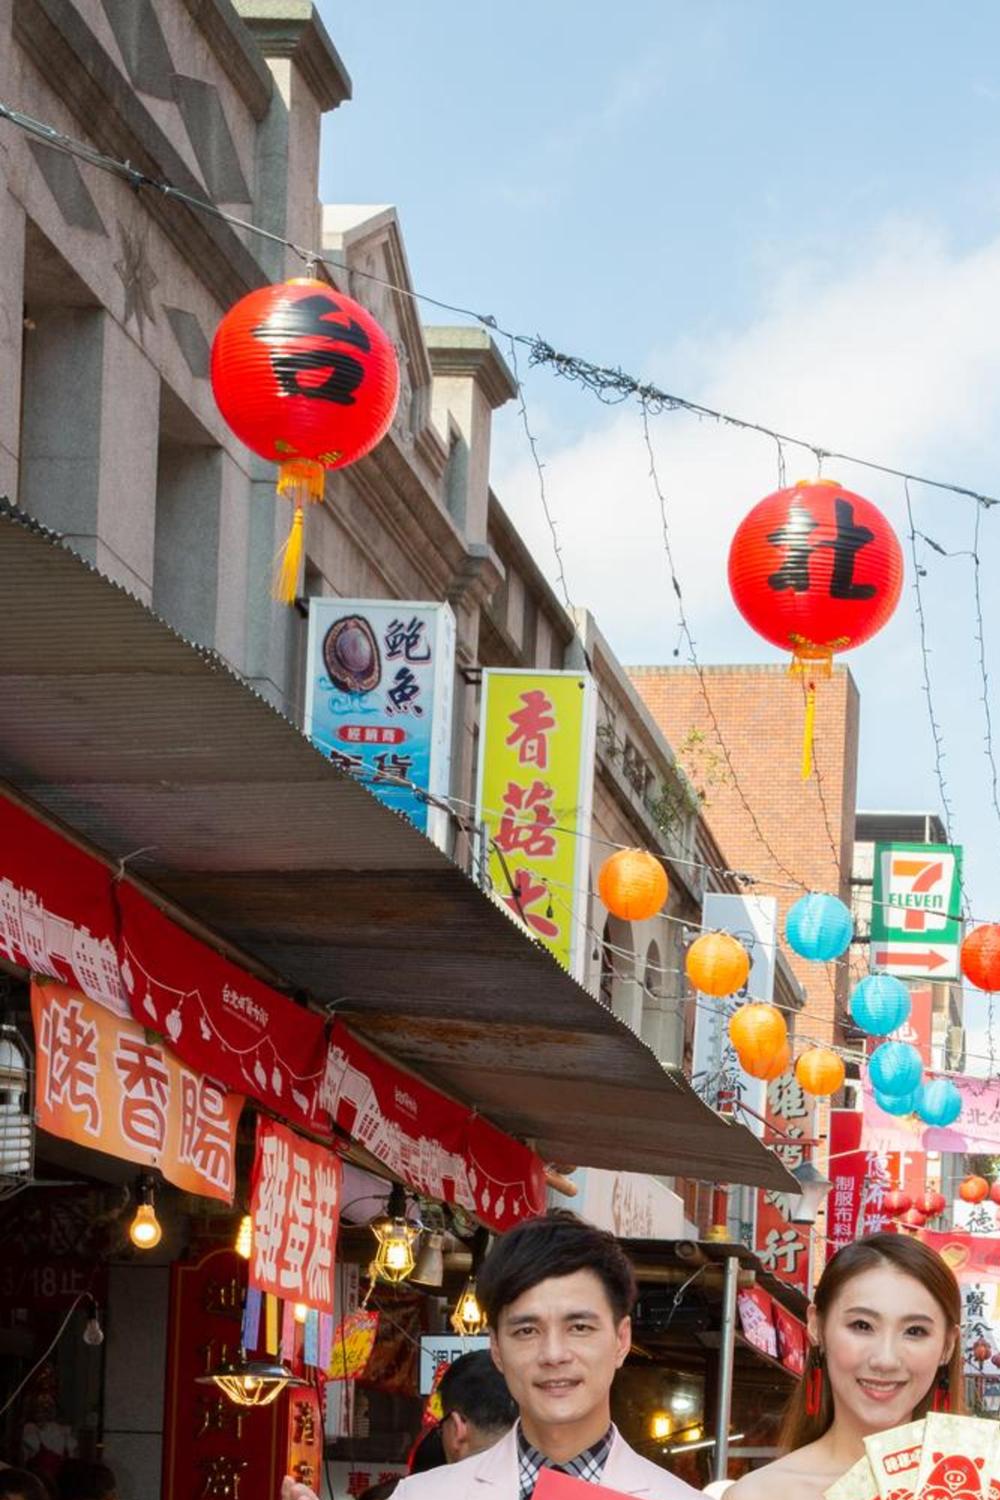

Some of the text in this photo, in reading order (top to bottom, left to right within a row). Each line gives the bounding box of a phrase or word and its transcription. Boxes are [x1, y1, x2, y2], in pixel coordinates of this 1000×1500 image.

[252, 294, 372, 406] 台
[767, 498, 874, 600] 北
[384, 616, 431, 716] 鮑魚
[347, 726, 396, 743] 經銷商
[888, 892, 944, 909] ELEVEN
[40, 997, 233, 1193] 烤香腸
